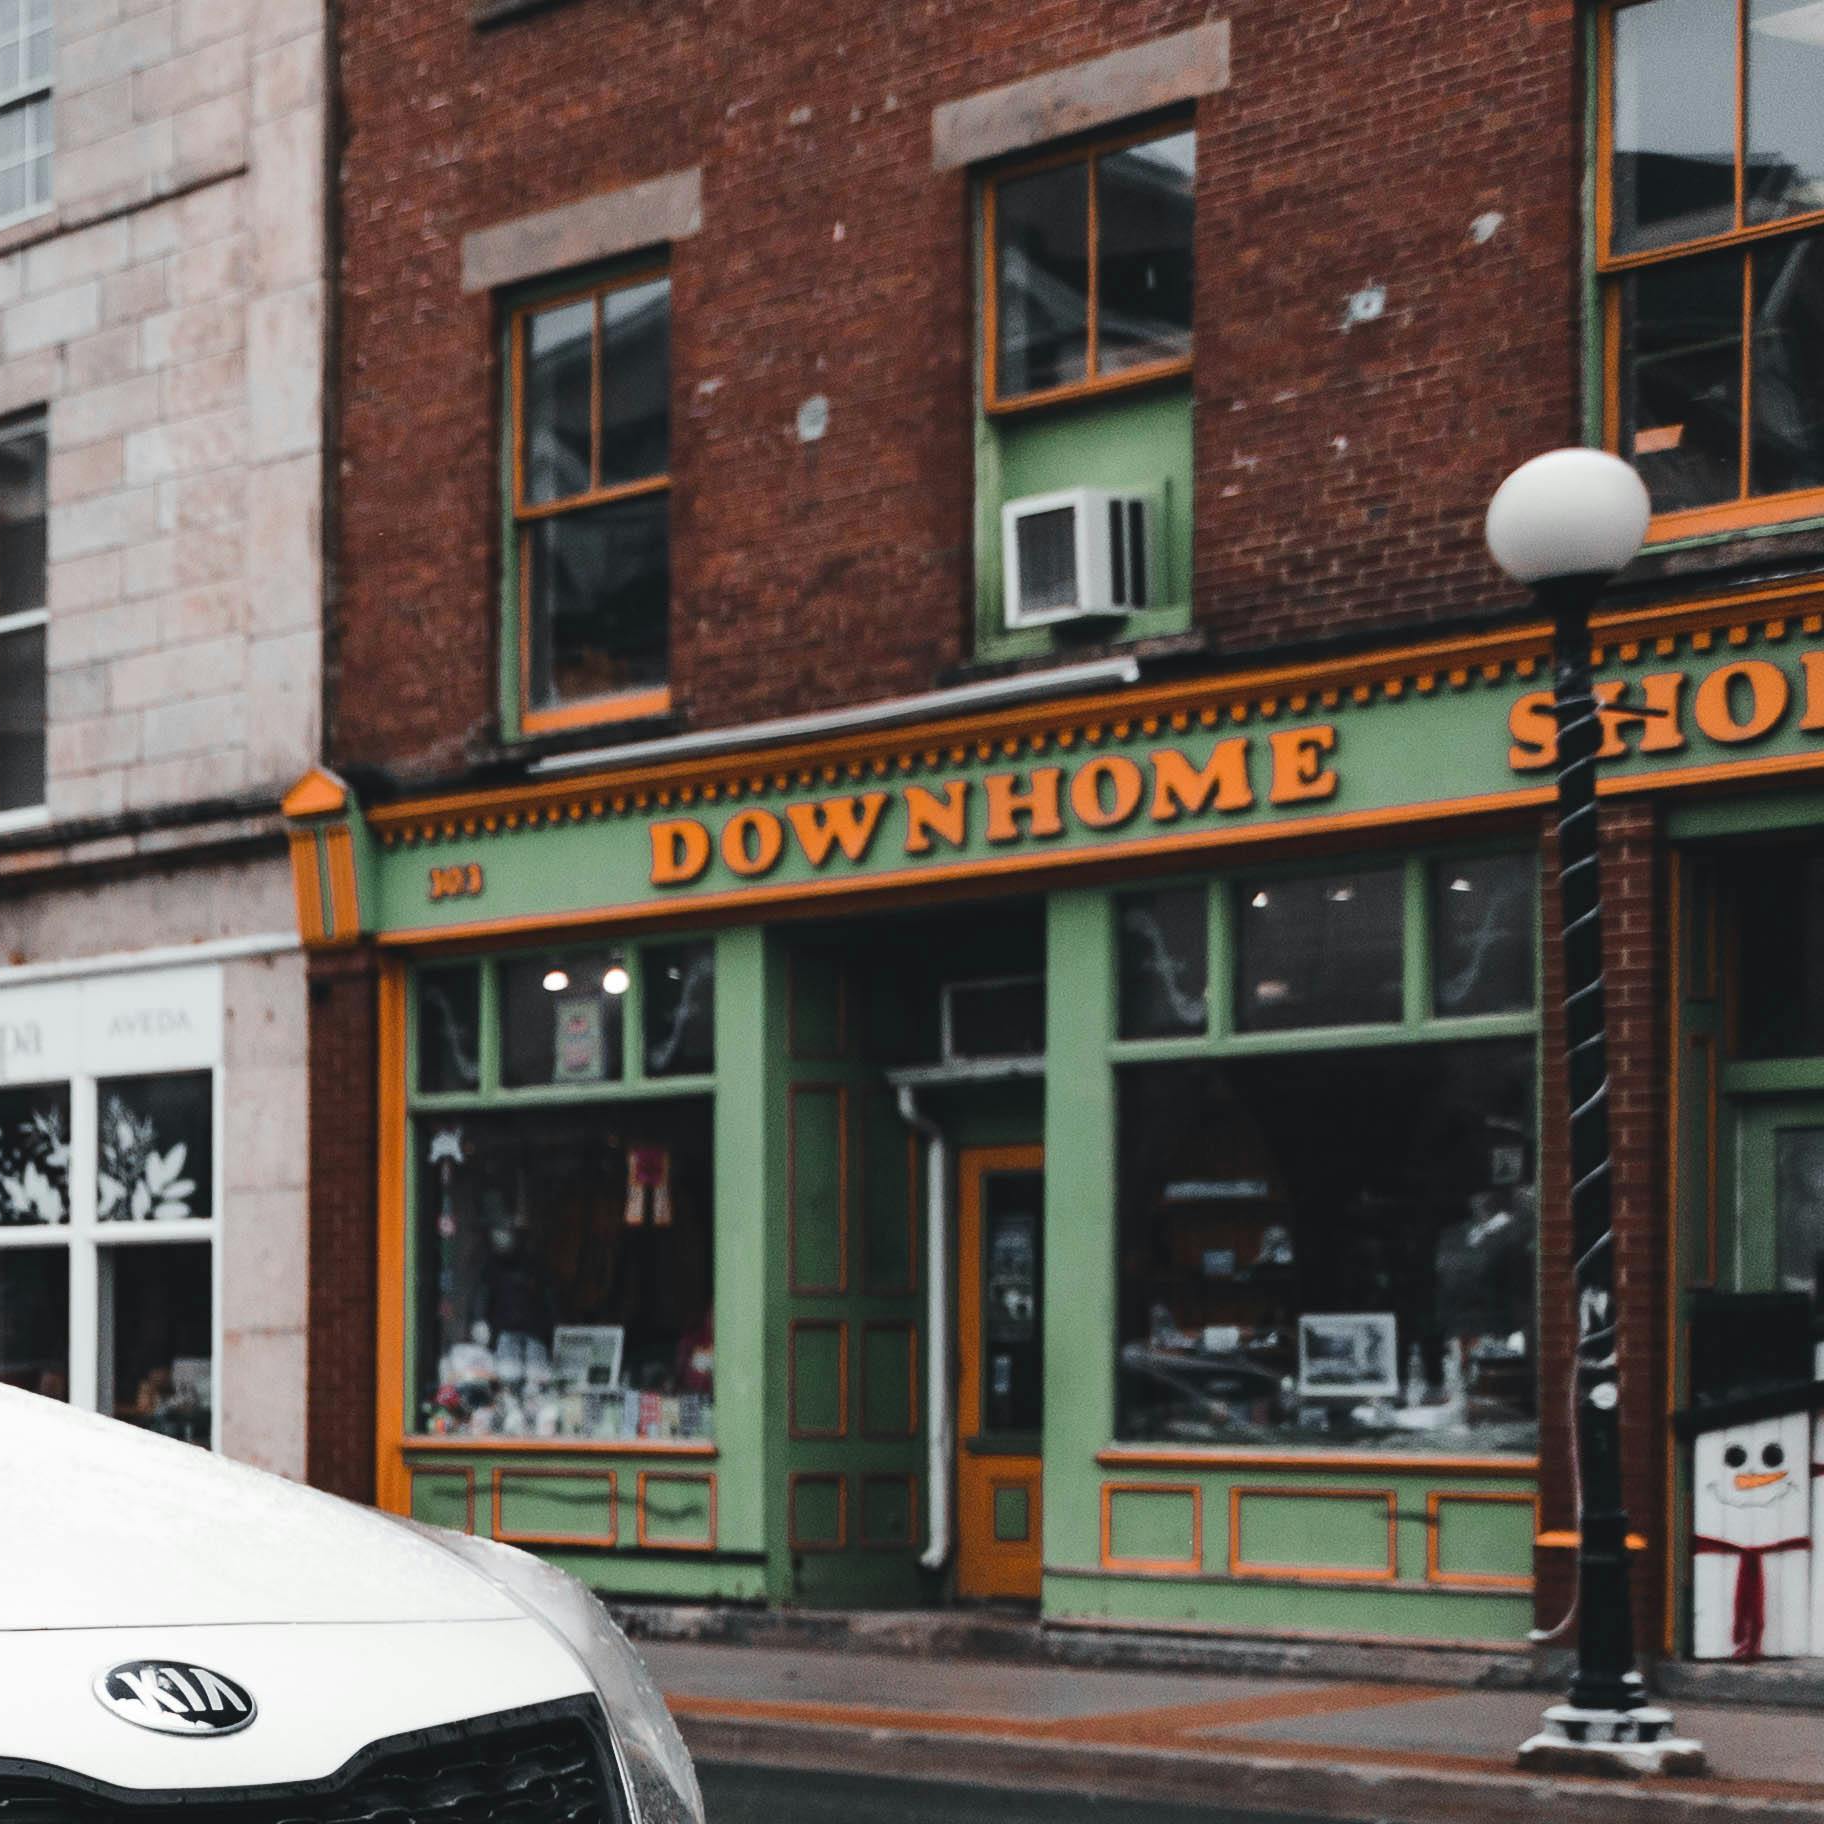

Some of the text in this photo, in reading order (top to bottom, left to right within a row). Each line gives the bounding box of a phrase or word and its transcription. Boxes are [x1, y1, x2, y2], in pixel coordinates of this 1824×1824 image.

[649, 650, 1824, 884] DOWNHOME SHO
[115, 1666, 249, 1713] KIA
